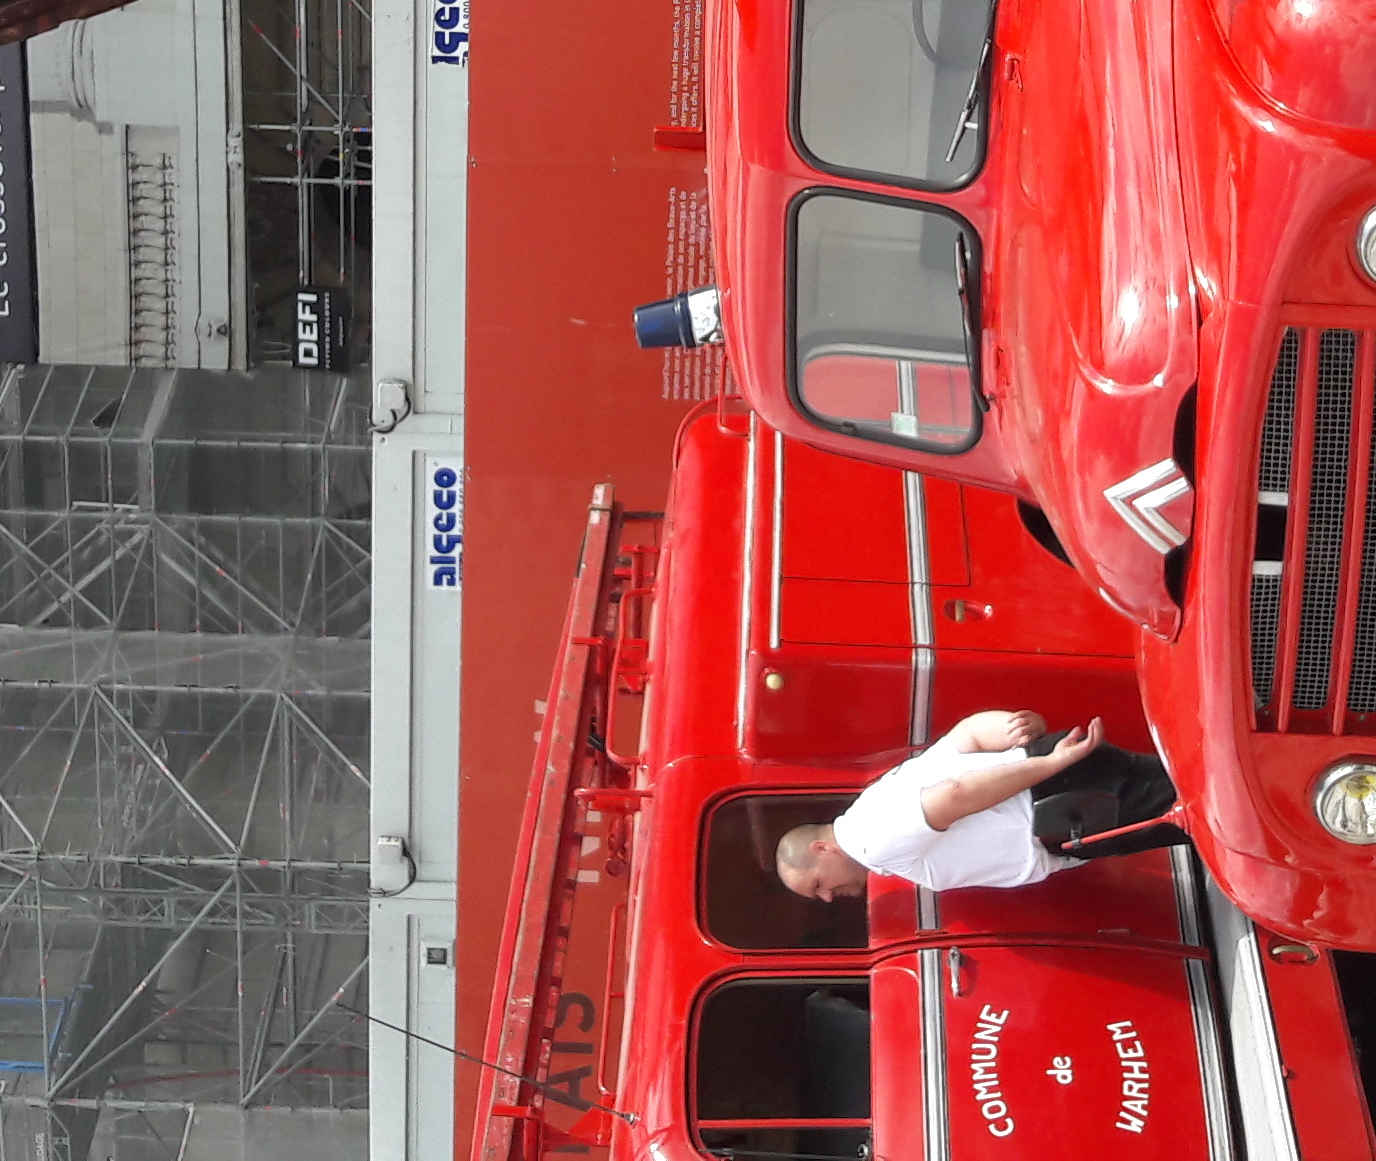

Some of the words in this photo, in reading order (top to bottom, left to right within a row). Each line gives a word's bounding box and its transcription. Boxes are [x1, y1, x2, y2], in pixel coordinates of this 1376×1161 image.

[680, 92, 690, 126] ndergoing
[297, 292, 318, 365] DEFI
[430, 467, 463, 586] algeco
[970, 1003, 1015, 1137] COMMUNE
[1045, 1055, 1074, 1085] de
[1105, 1019, 1150, 1134] WARHEM
